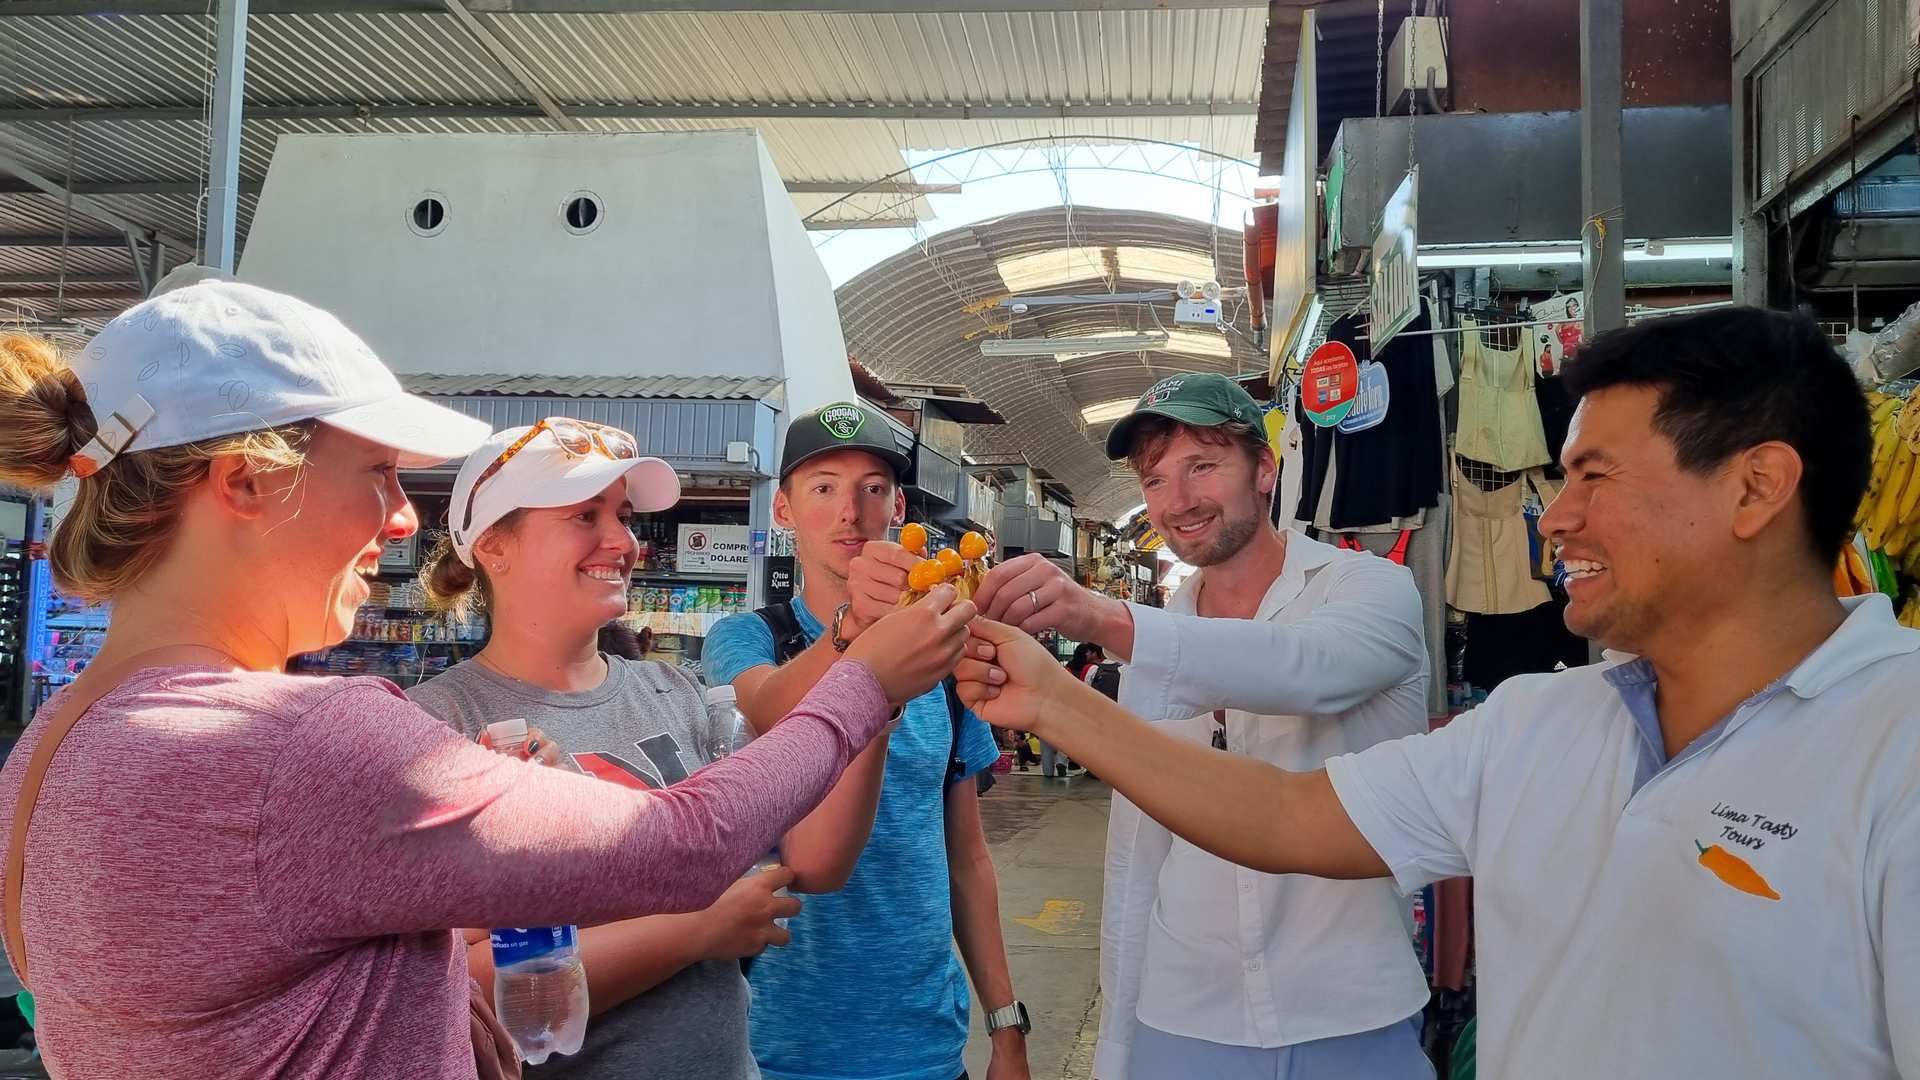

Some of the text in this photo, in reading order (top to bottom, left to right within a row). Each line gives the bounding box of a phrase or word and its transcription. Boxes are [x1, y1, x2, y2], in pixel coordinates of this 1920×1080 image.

[825, 408, 860, 423] GOOGAN
[710, 553, 748, 563] DÓLARE
[772, 571, 789, 579] Otto
[771, 579, 790, 589] Kunz
[1710, 802, 1799, 840] Lima Tasty
[1720, 825, 1766, 850] Tours
